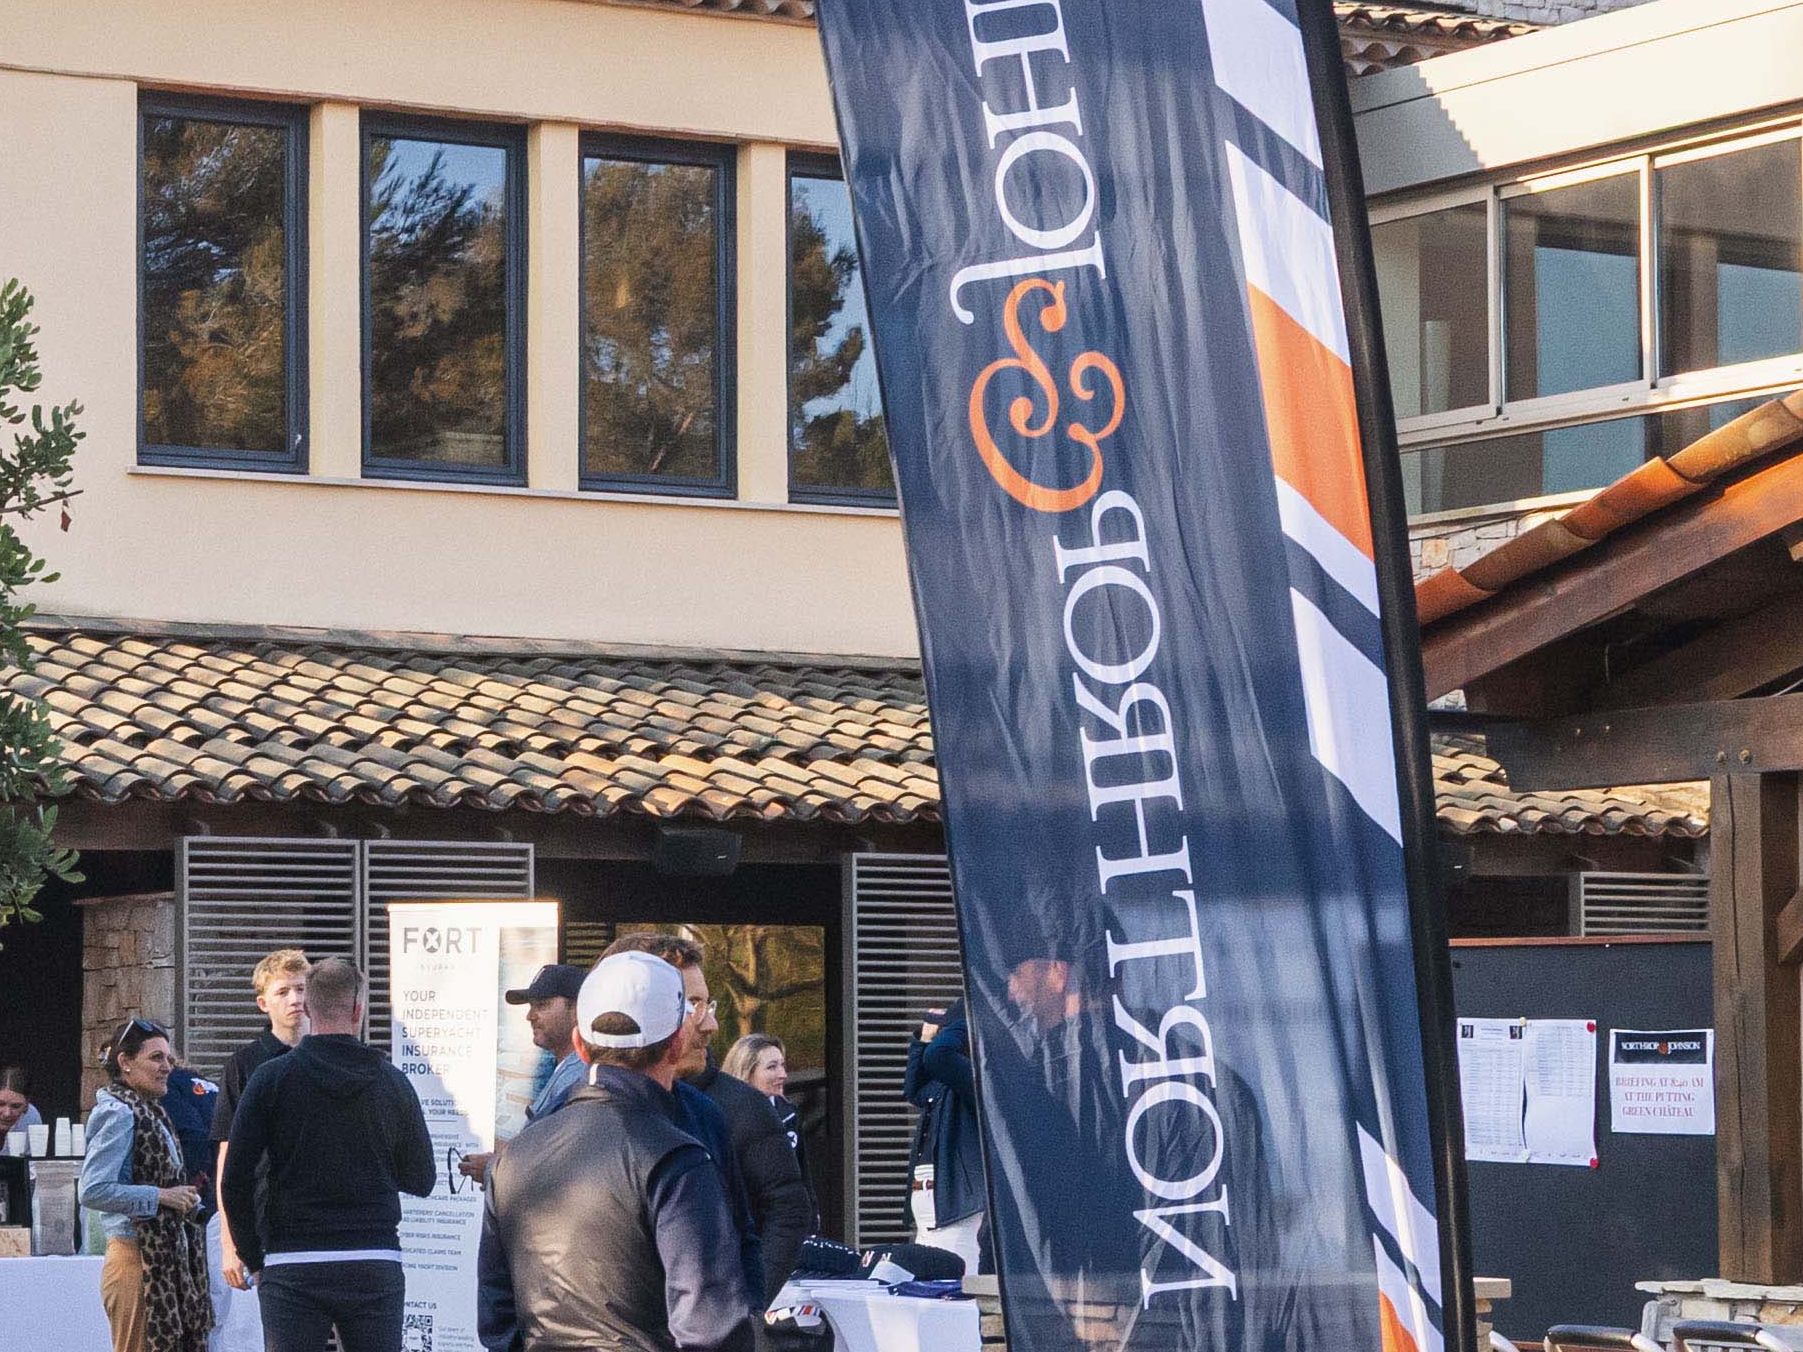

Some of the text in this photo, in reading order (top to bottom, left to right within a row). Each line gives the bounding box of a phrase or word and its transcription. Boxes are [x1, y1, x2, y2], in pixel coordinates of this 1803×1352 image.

[403, 927, 482, 954] FORT
[403, 990, 436, 1002] YOUR
[402, 1009, 489, 1020] INDEPENDENT
[402, 1026, 481, 1038] SUPERYACHT
[402, 1044, 472, 1058] INSURANCE
[402, 1063, 450, 1075] BROKER
